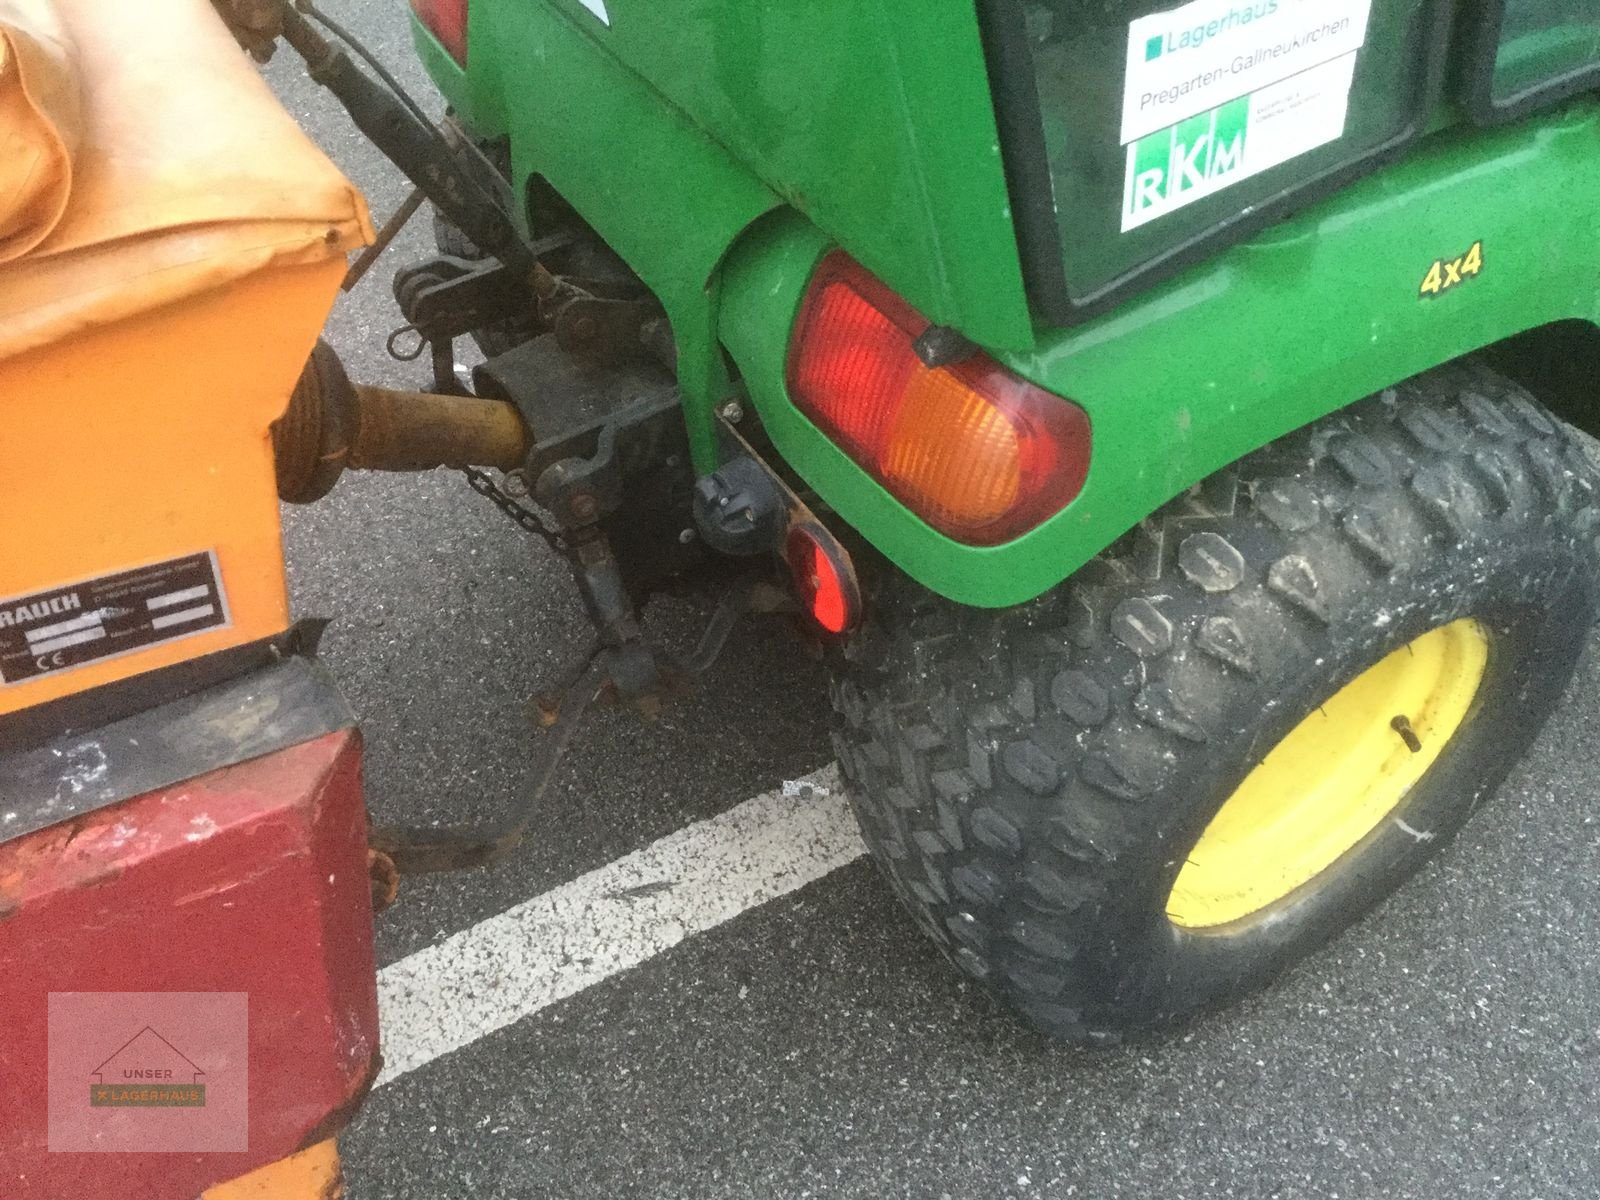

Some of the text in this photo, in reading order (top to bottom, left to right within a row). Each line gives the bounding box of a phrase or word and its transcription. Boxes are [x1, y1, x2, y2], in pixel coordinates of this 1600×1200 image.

[1167, 0, 1278, 53] Lagerhaus
[1140, 16, 1349, 110] Pregarten-Gallneukirchen
[1131, 130, 1243, 214] RKM
[1420, 240, 1482, 295] 4x4
[0, 592, 81, 628] RAUCH
